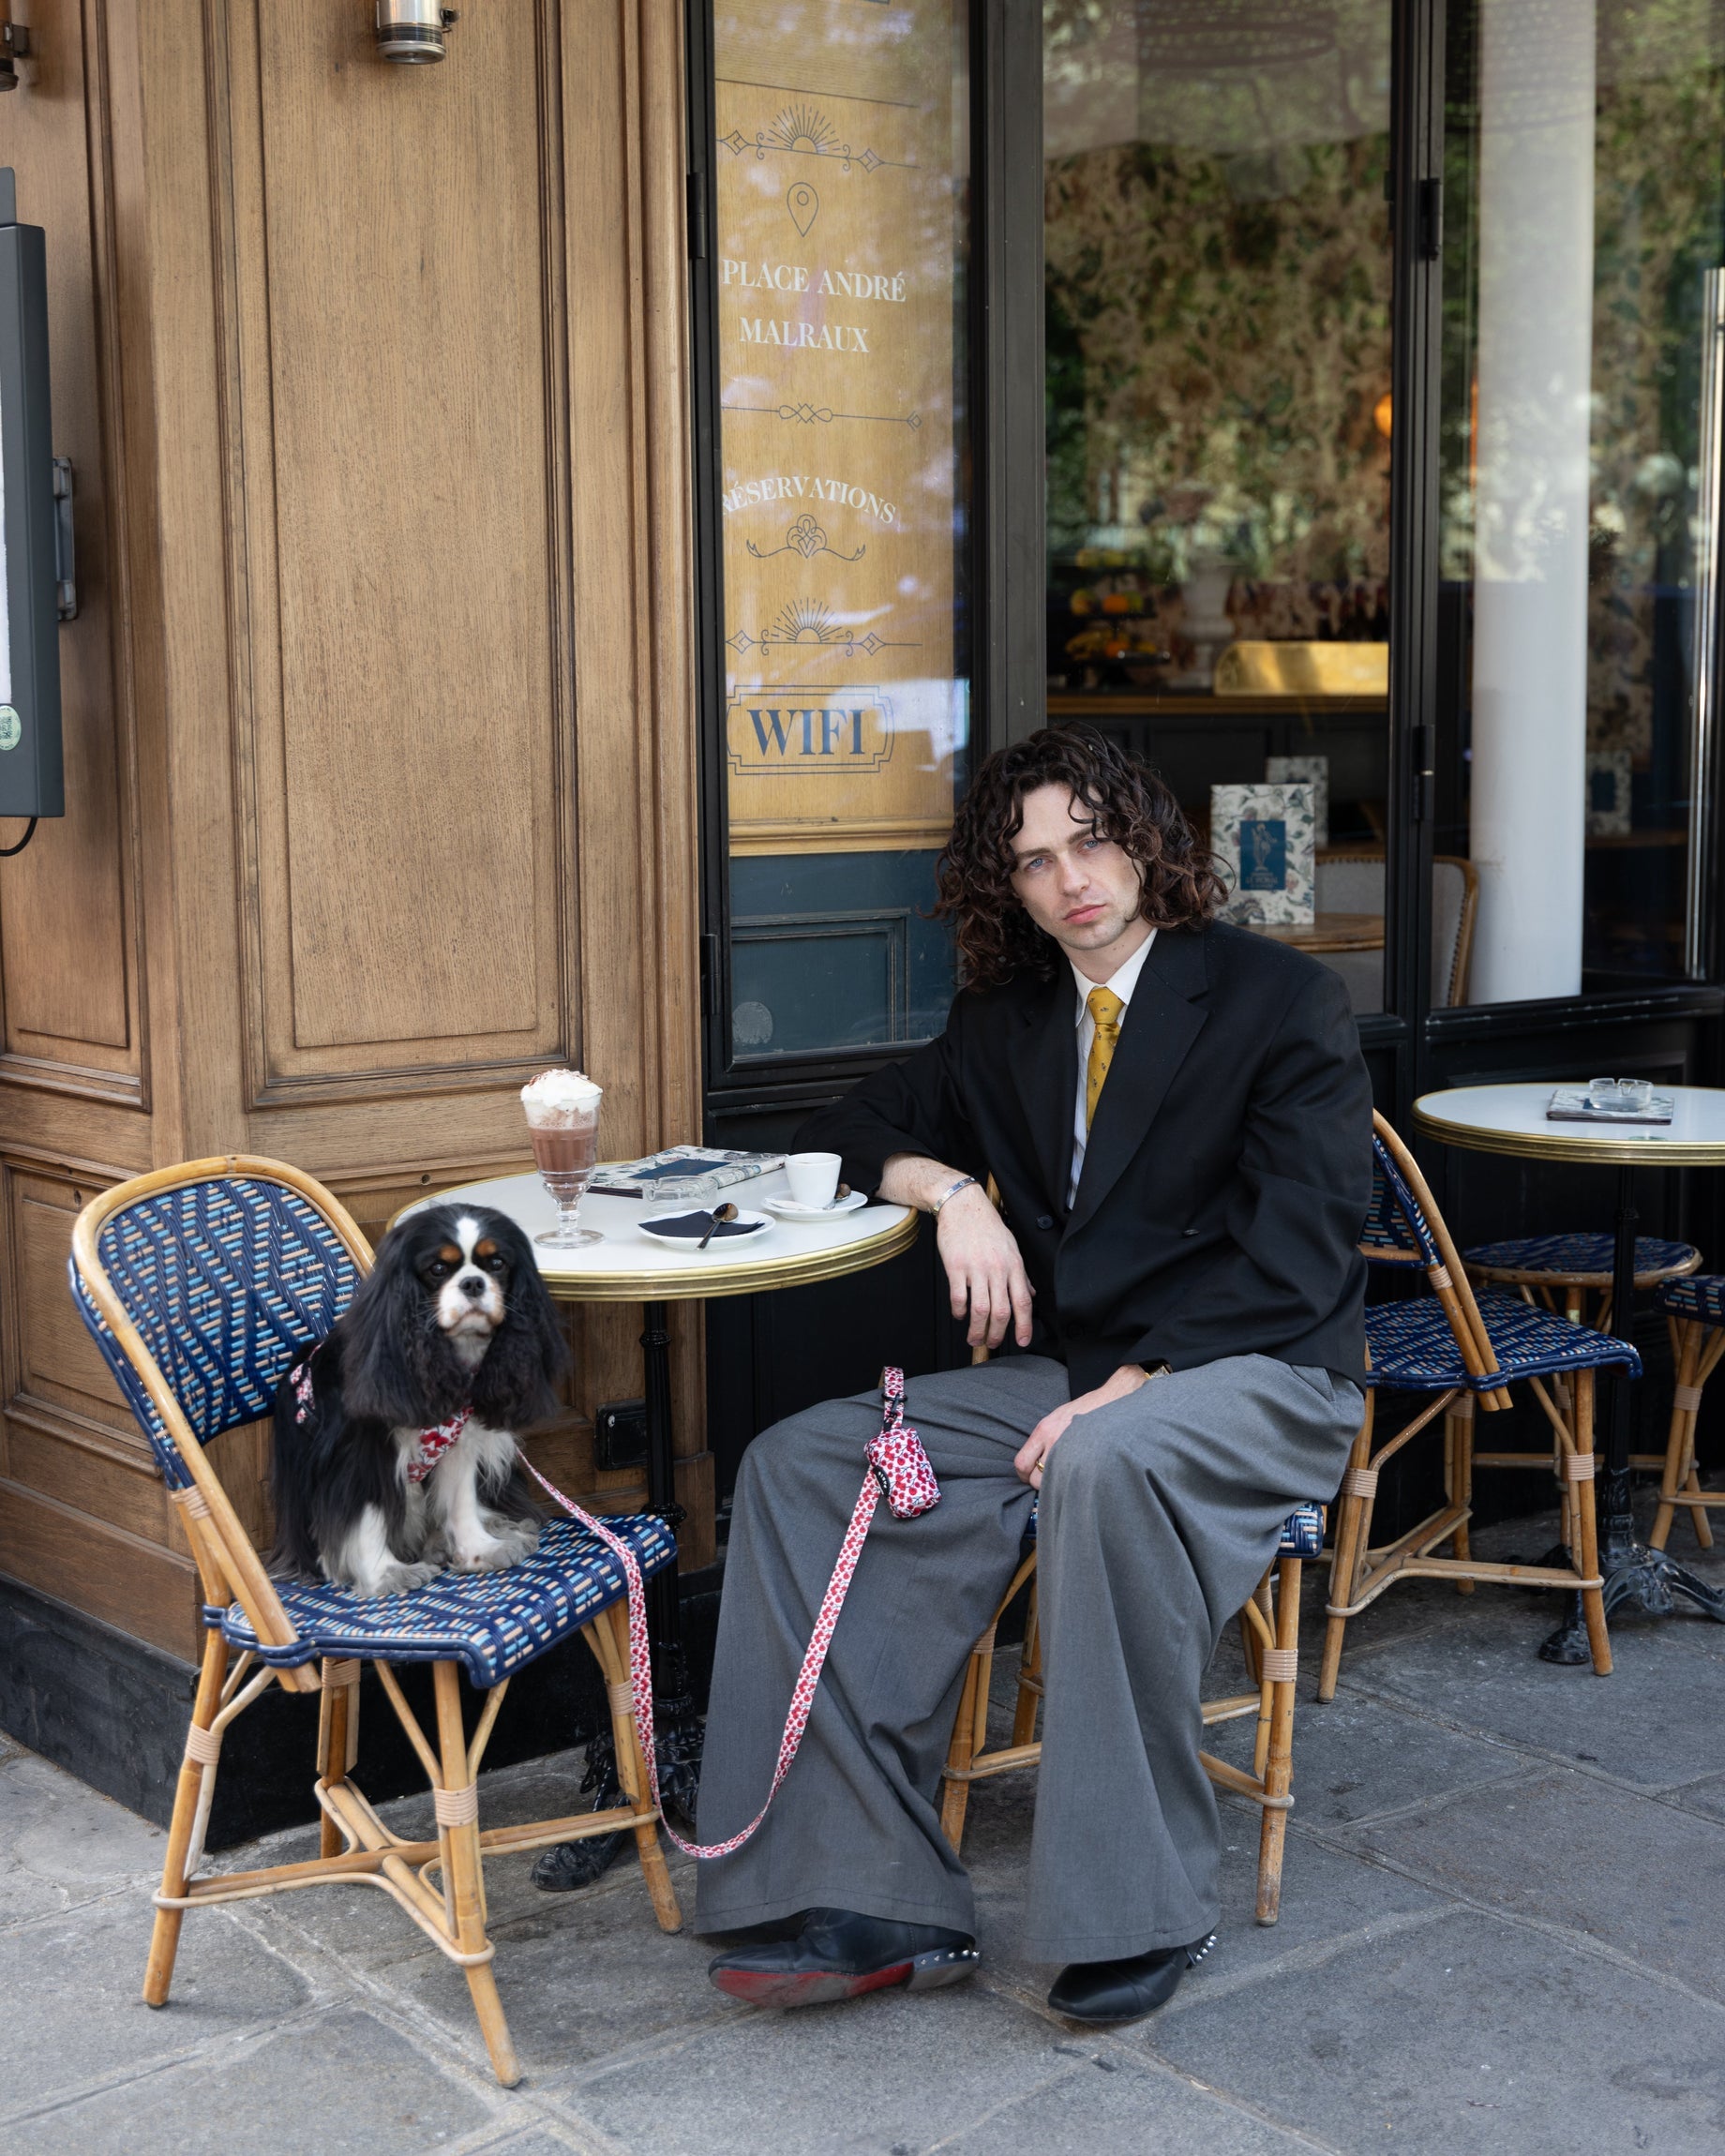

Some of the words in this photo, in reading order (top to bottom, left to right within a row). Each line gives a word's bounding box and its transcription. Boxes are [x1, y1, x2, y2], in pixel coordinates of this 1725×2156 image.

[722, 259, 810, 292] PLACE
[818, 270, 907, 303] ANDRÉ
[740, 317, 870, 353] MALRAUX
[746, 709, 866, 756] WIFI
